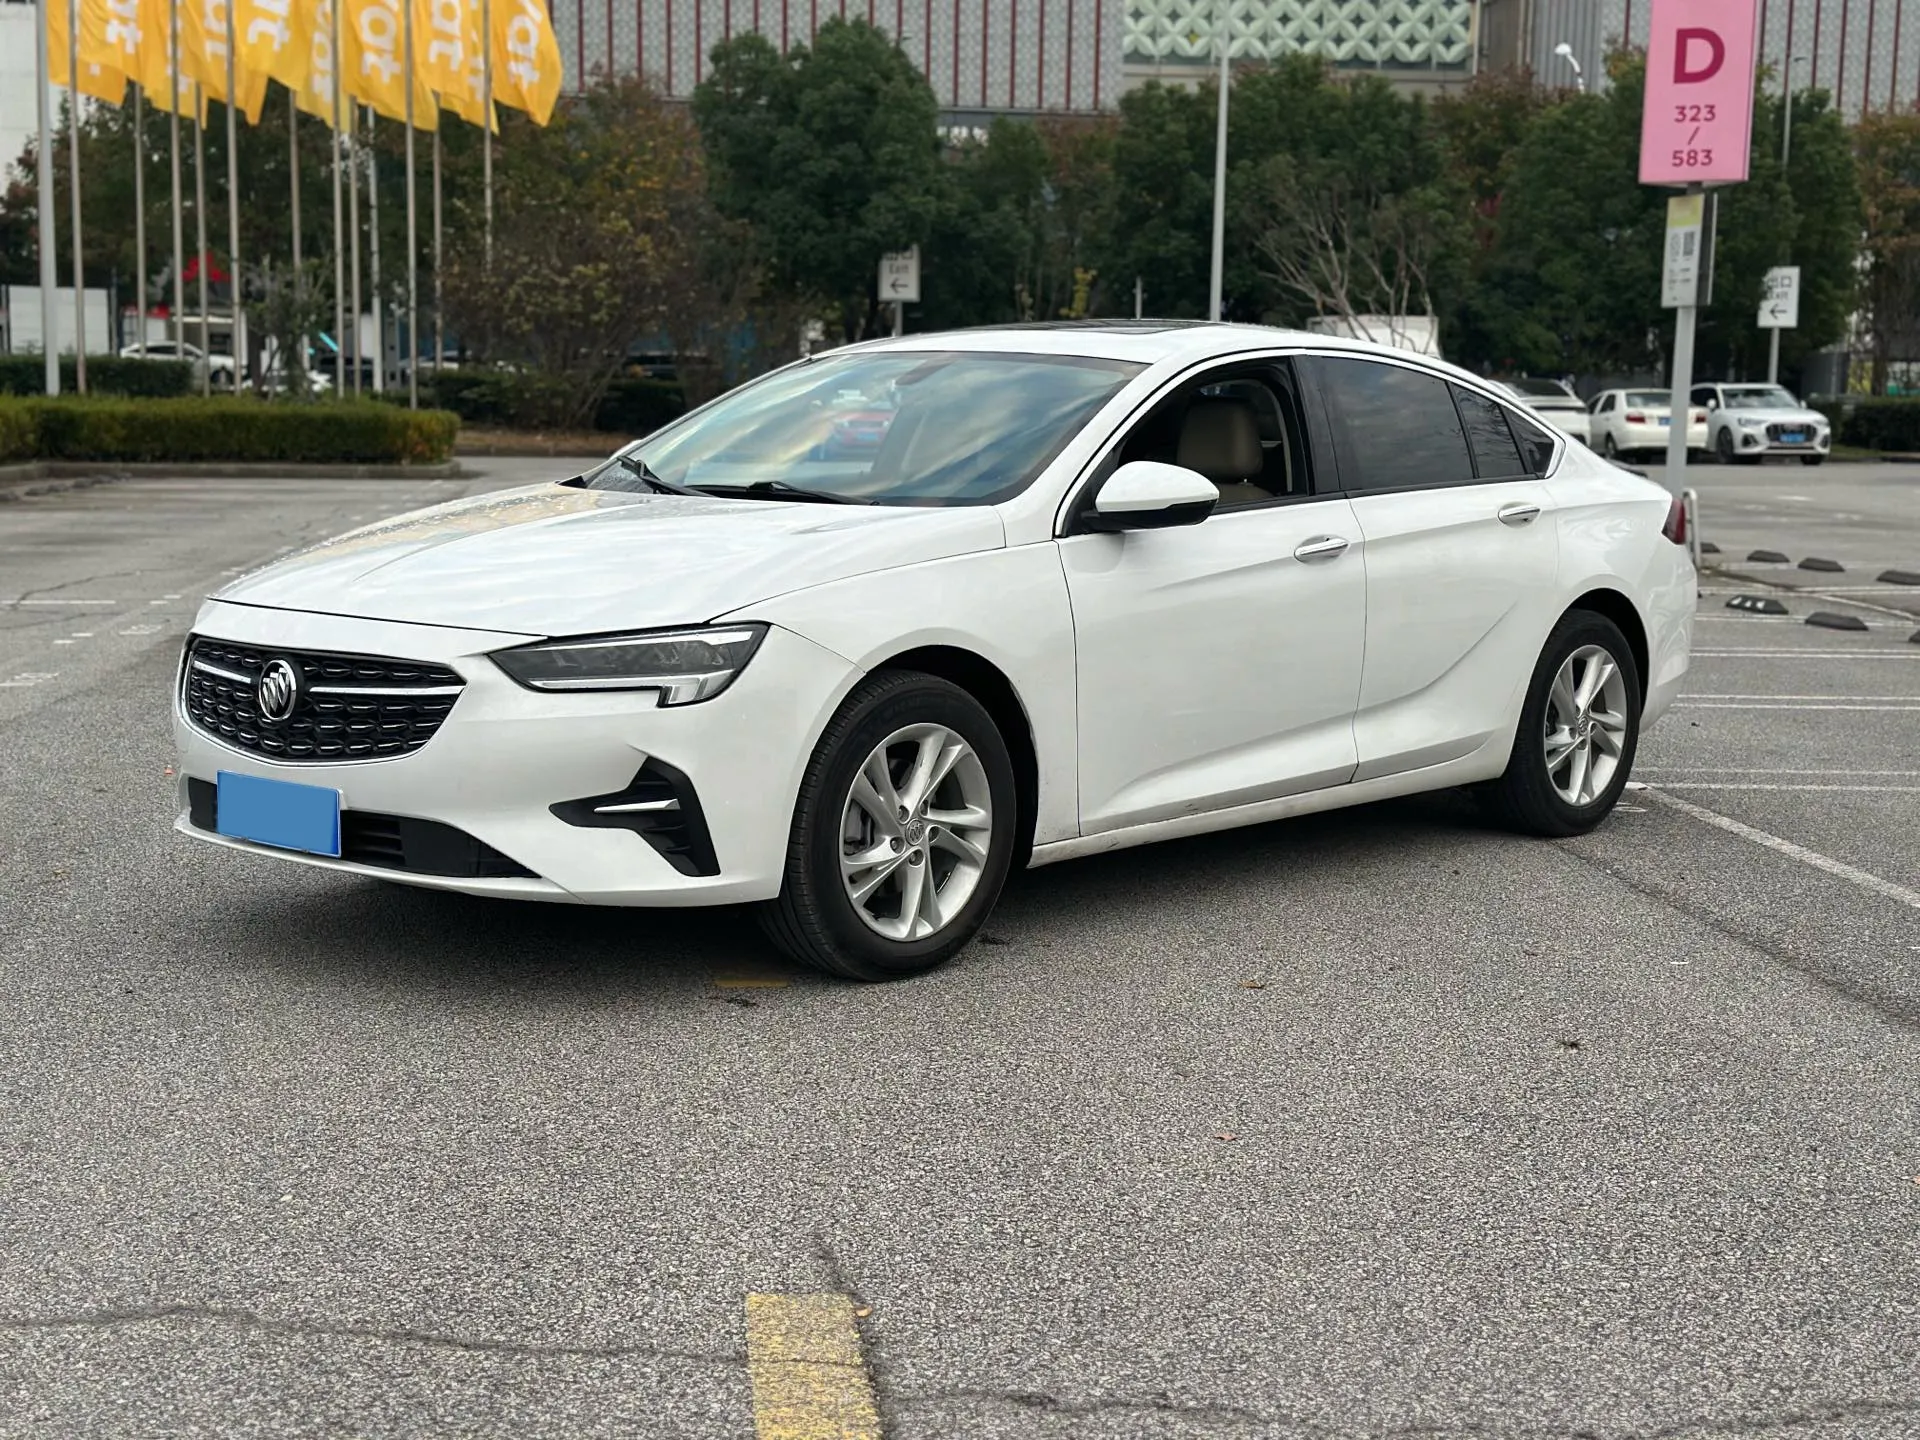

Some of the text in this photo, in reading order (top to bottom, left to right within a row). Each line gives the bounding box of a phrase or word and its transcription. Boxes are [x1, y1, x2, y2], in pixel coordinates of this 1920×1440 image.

[1673, 27, 1726, 84] D
[1674, 104, 1716, 123] 323
[1671, 149, 1713, 167] 583
